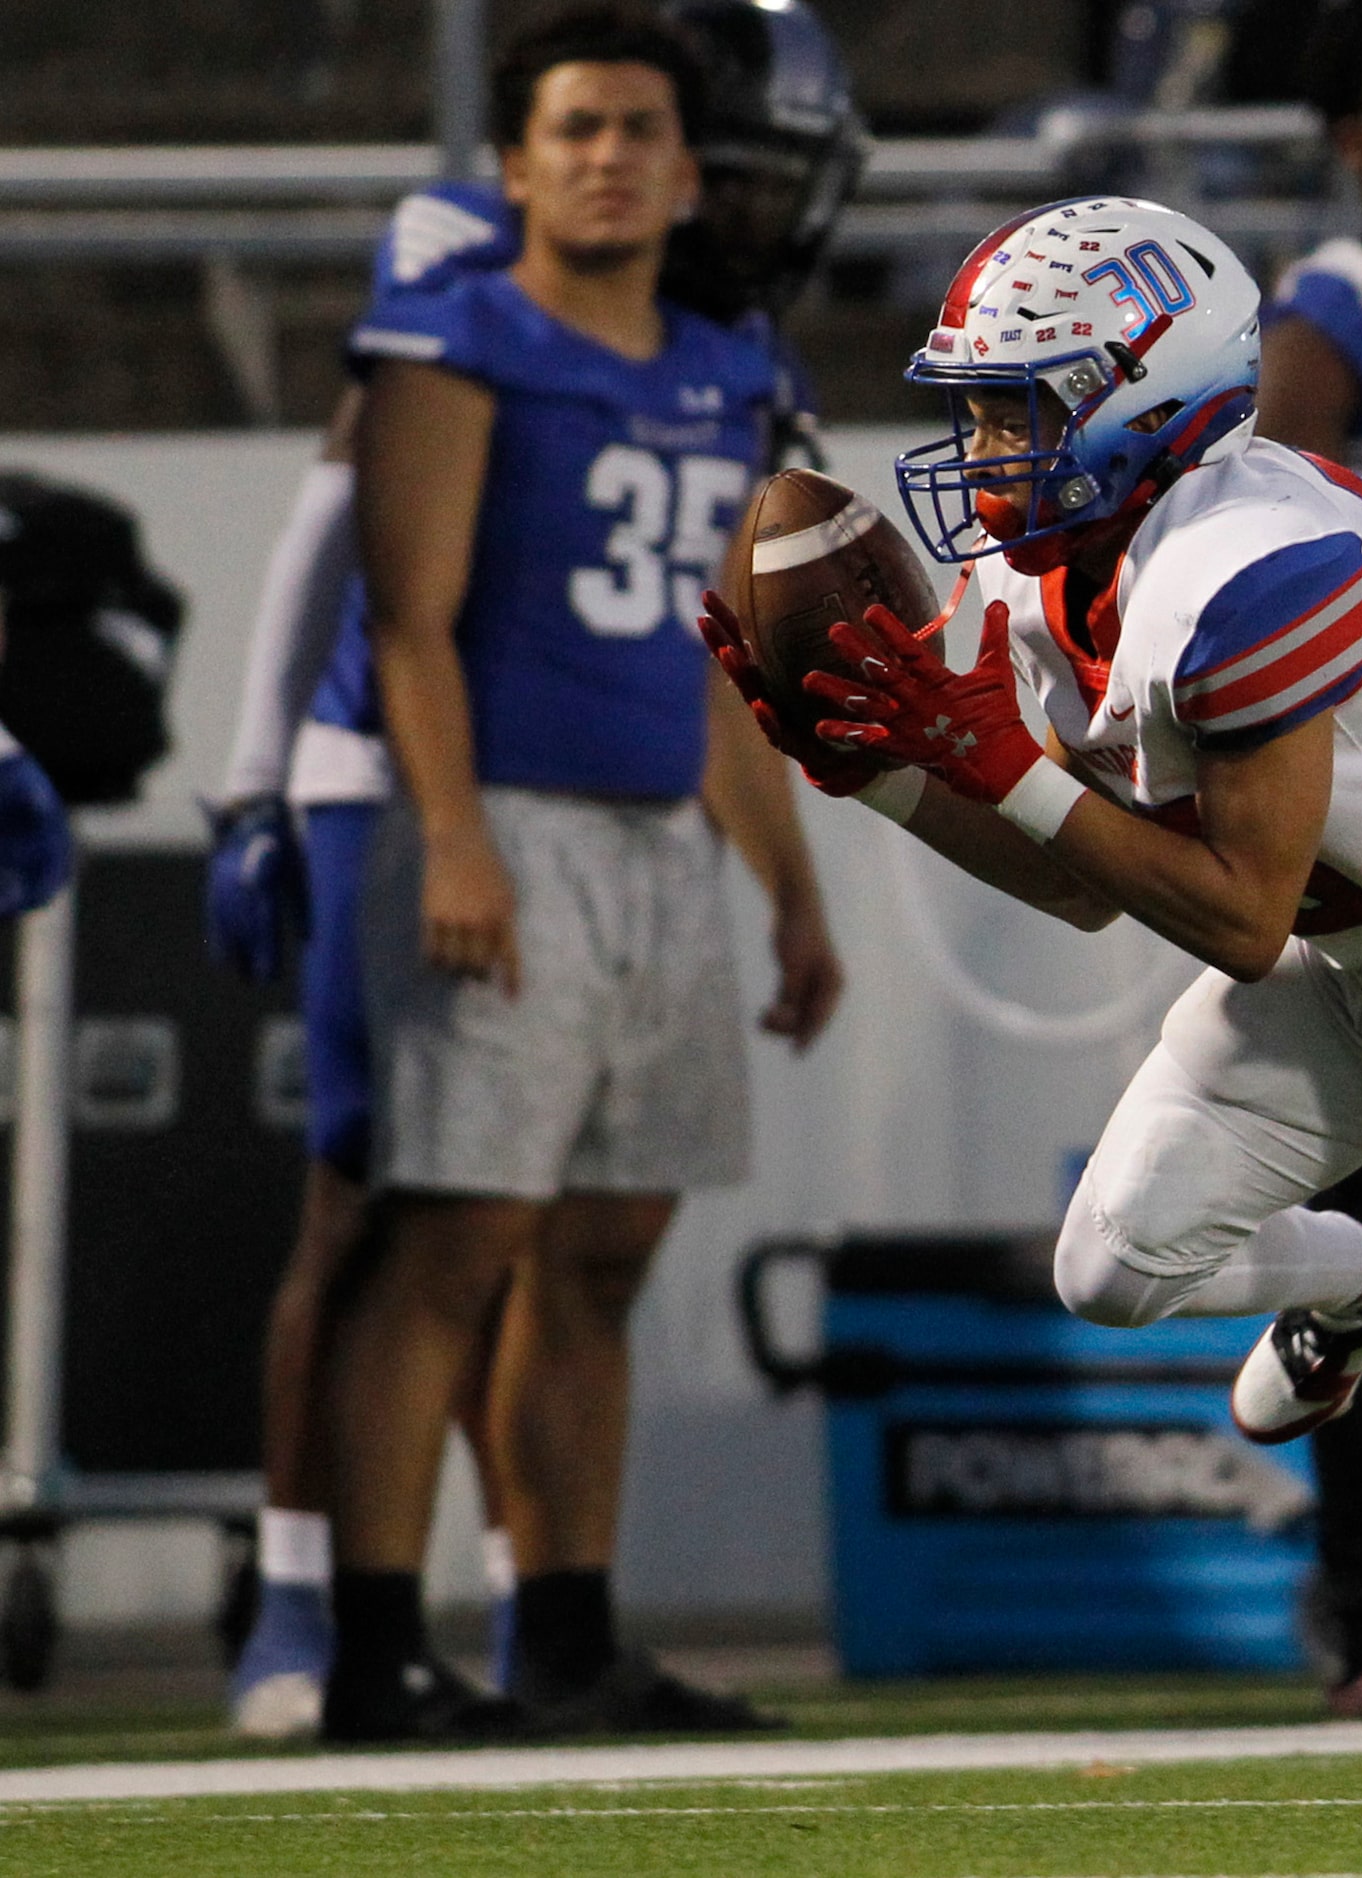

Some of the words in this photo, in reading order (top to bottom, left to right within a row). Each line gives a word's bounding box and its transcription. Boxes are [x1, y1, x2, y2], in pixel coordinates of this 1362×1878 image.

[1079, 241, 1100, 252] 22
[1081, 239, 1196, 345] 30
[1035, 327, 1057, 343] 22
[1071, 321, 1093, 337] 22
[567, 442, 749, 642] 35
